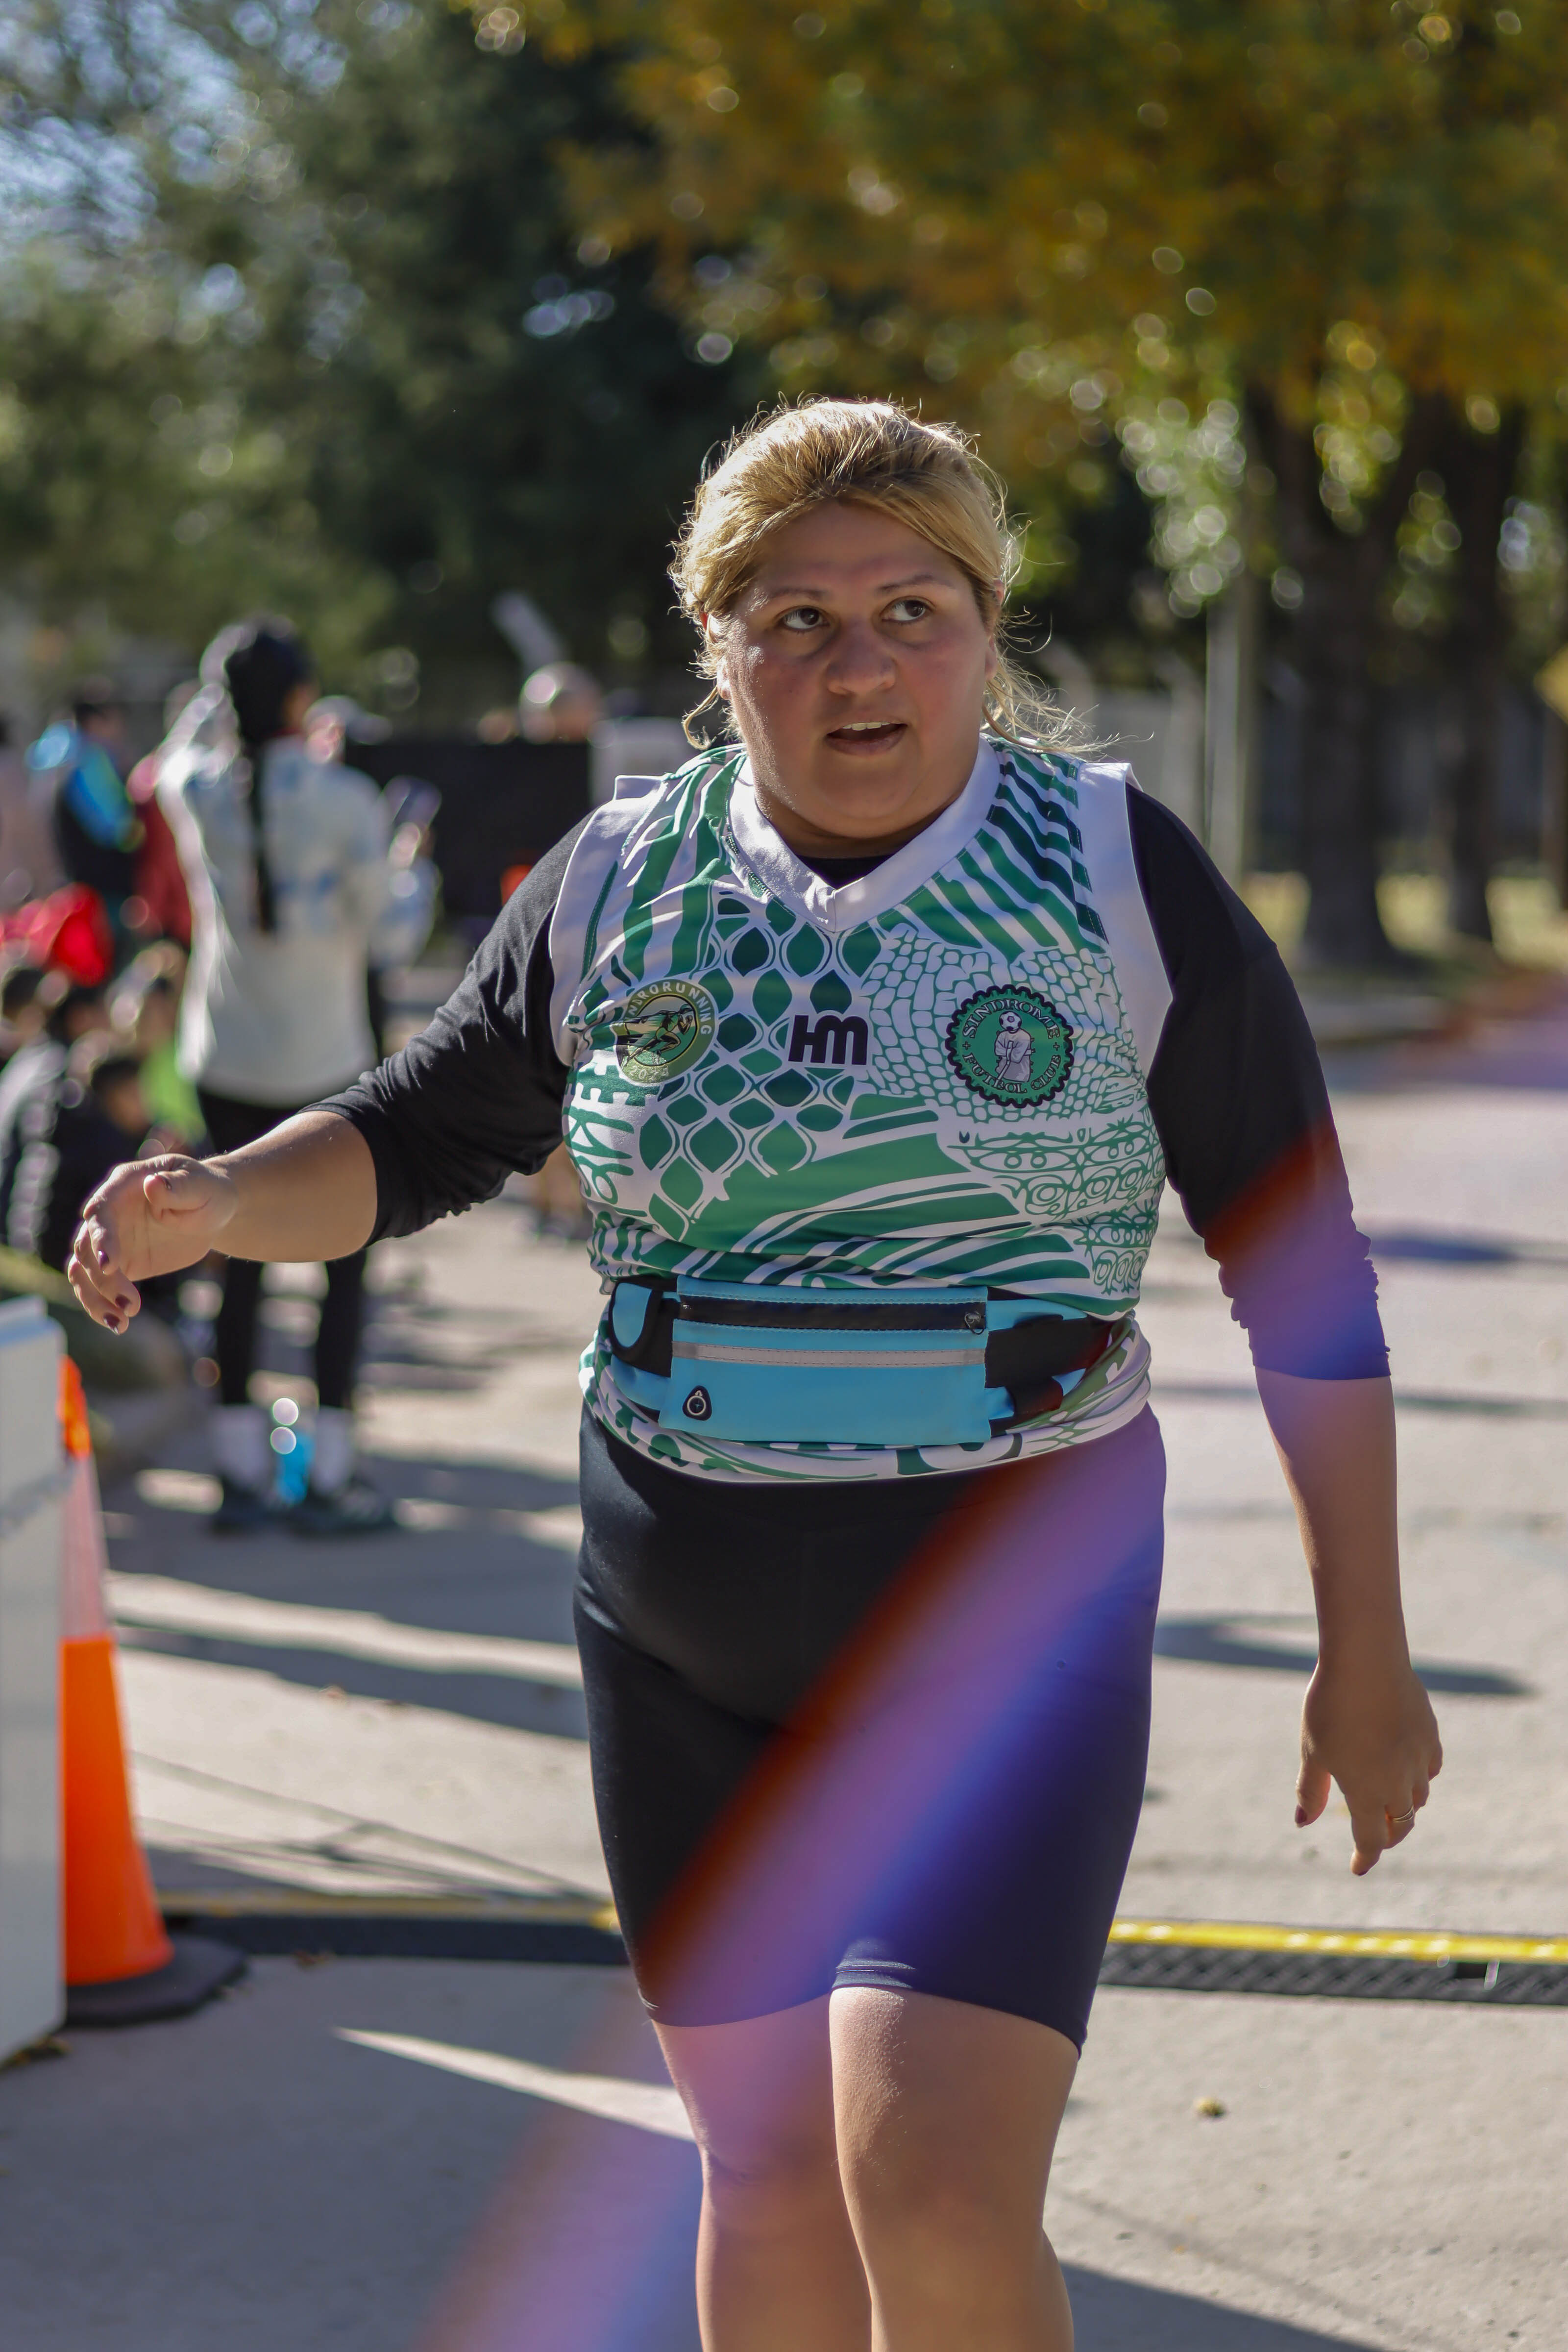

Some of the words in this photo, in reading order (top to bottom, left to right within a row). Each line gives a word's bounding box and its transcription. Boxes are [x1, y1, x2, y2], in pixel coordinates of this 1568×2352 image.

[621, 981, 712, 1035] NDRORUNNING
[962, 998, 1060, 1039] SINDROME
[962, 1052, 1028, 1094] FUTBOL
[1030, 1054, 1061, 1090] CLUB
